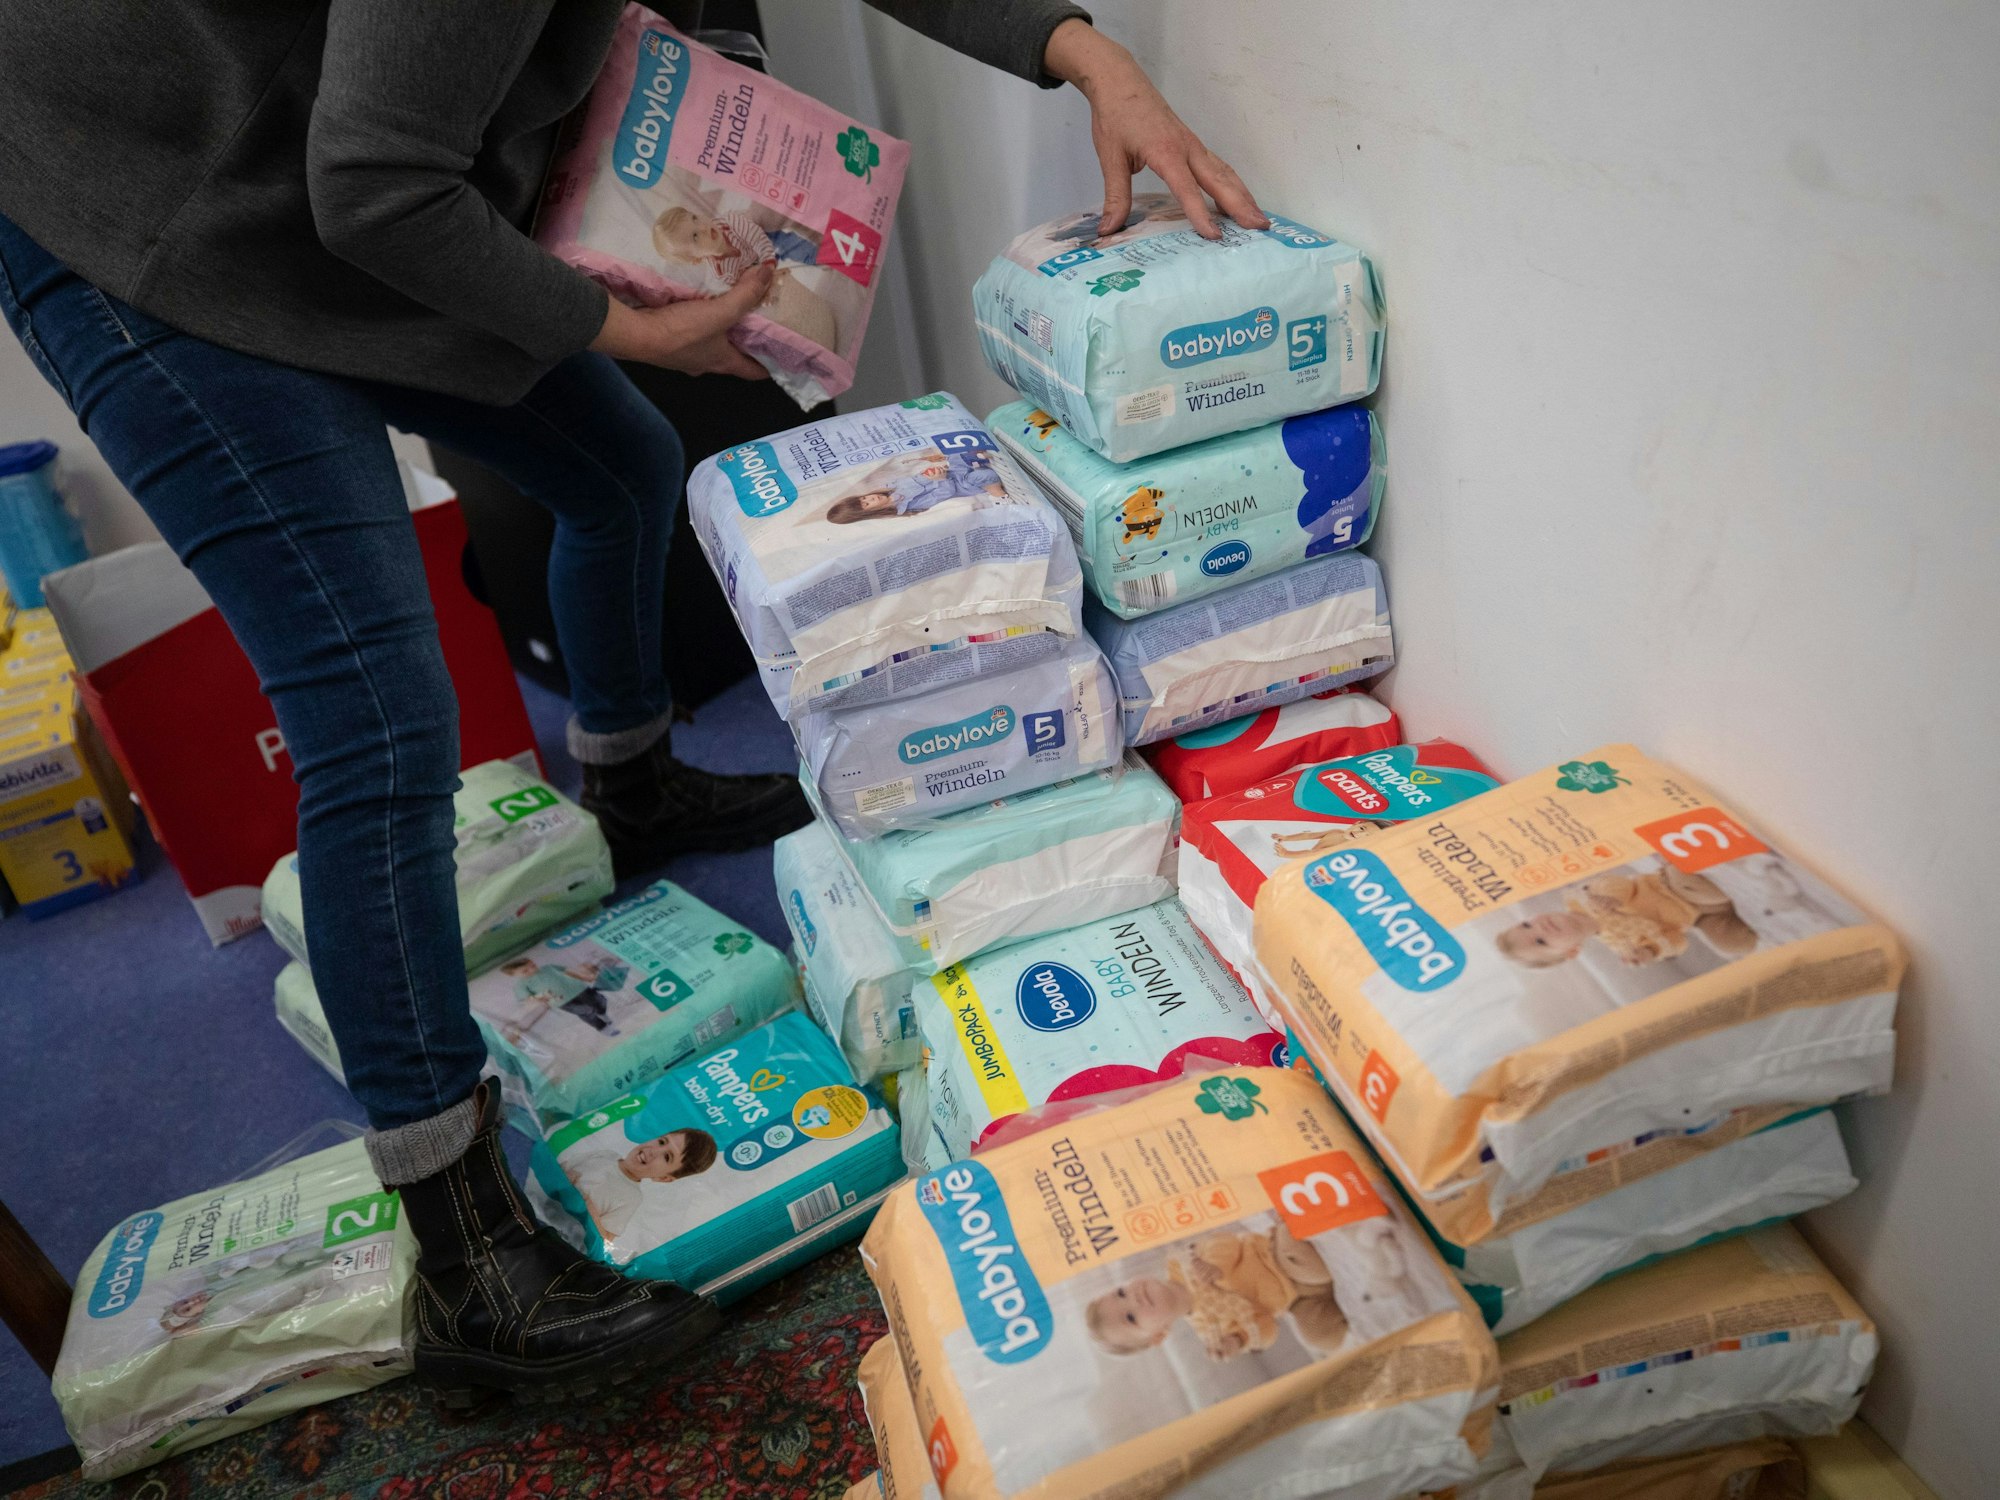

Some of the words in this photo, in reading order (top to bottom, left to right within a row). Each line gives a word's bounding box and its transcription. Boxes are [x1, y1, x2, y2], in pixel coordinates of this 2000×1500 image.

[622, 41, 681, 181] babylove
[697, 89, 728, 169] Premium-
[714, 84, 754, 175] Windeln
[831, 229, 864, 266] 4
[1168, 323, 1273, 361] babylove
[1292, 320, 1326, 358] 5+
[1186, 383, 1265, 412] Windeln
[804, 428, 842, 474] Windeln
[941, 435, 979, 448] 5
[738, 443, 789, 511] babylove
[1184, 495, 1258, 528] WINDELN
[1206, 518, 1240, 539] BABY
[1333, 516, 1353, 543] 5
[1208, 550, 1246, 570] bevola
[905, 718, 1009, 759] babylove
[1035, 716, 1057, 743] 5
[925, 759, 989, 784] Premium-
[925, 768, 1006, 797] Windeln
[1322, 772, 1380, 809] pants
[1357, 754, 1431, 806] Pampers
[500, 792, 540, 816] 2
[1660, 822, 1729, 858] 3
[53, 851, 83, 883] 3
[1429, 821, 1513, 903] Windeln
[553, 889, 662, 945] babylove
[607, 905, 681, 945] Windeln
[1330, 853, 1455, 987] babylove
[651, 976, 677, 998] 6
[1090, 956, 1136, 999] BABY
[1110, 922, 1186, 1017] WINDELN
[1035, 969, 1076, 1024] bevola
[959, 1002, 1008, 1081] JUMBOPACK
[621, 1099, 641, 1110] 7
[683, 1076, 728, 1127] baby-dry
[697, 1049, 769, 1123] Pampers
[1366, 1071, 1387, 1111] 3
[1052, 1137, 1121, 1256] Windeln
[1280, 1171, 1349, 1216] 3
[332, 1202, 379, 1237] 2
[1034, 1166, 1089, 1266] Premium-
[99, 1216, 154, 1312] babylove
[945, 1168, 1039, 1354] babylove
